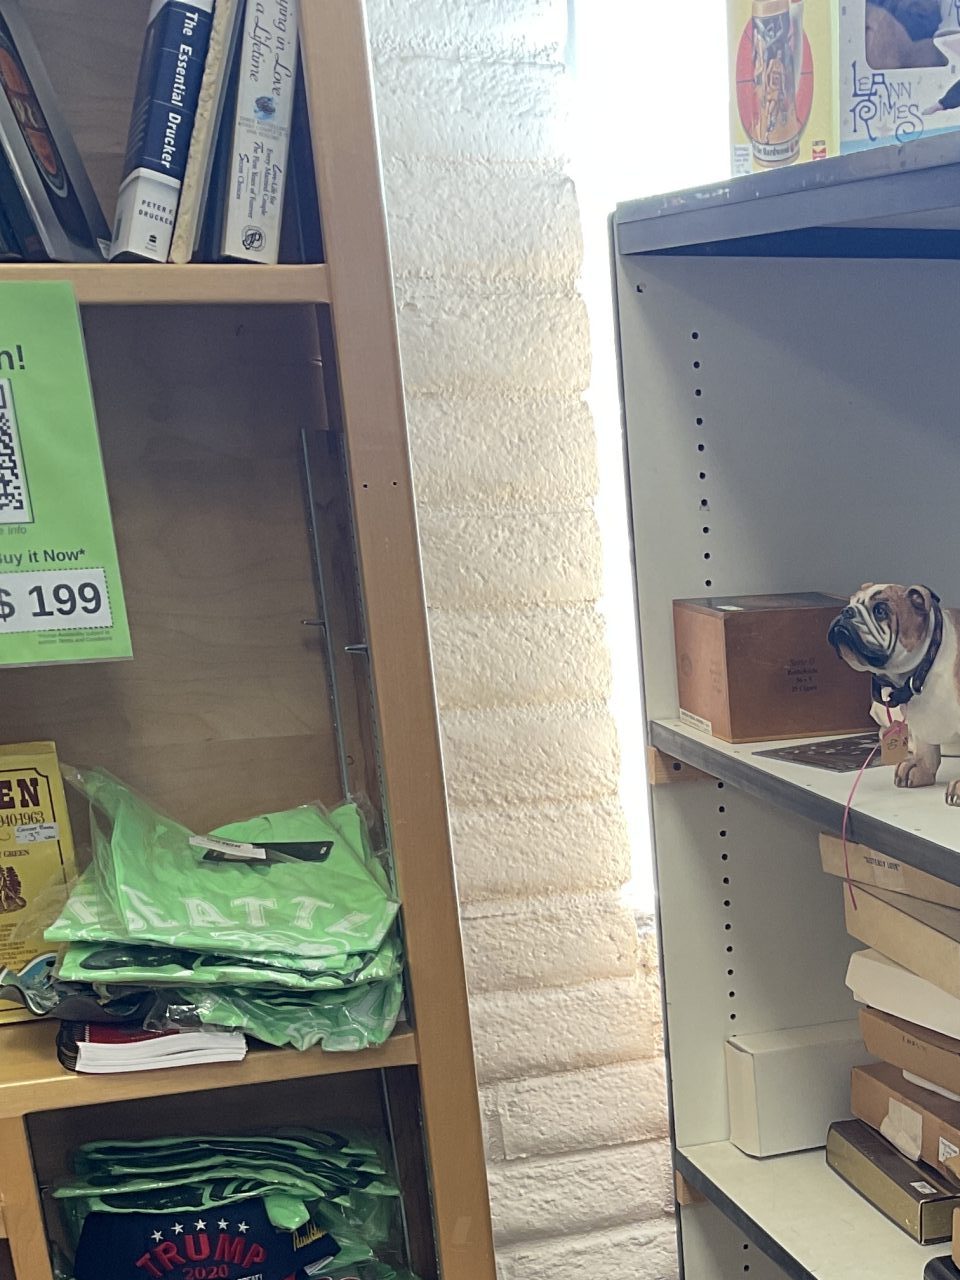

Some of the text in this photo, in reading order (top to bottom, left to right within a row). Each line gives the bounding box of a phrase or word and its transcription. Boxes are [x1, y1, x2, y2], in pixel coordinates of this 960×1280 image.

[248, 15, 273, 83] Lifetime
[275, 36, 291, 52] in
[272, 53, 292, 97] Love
[161, 12, 199, 169] The Essential Drucker
[141, 199, 167, 213] PETER
[138, 208, 173, 226] DRUCKER
[7, 526, 27, 536] info
[28, 549, 39, 564] it
[0, 582, 102, 622] $ 199
[0, 777, 40, 810] EN
[3, 849, 31, 858] GREEN
[136, 1231, 267, 1279] TRUMP
[182, 1264, 230, 1280] 2020
